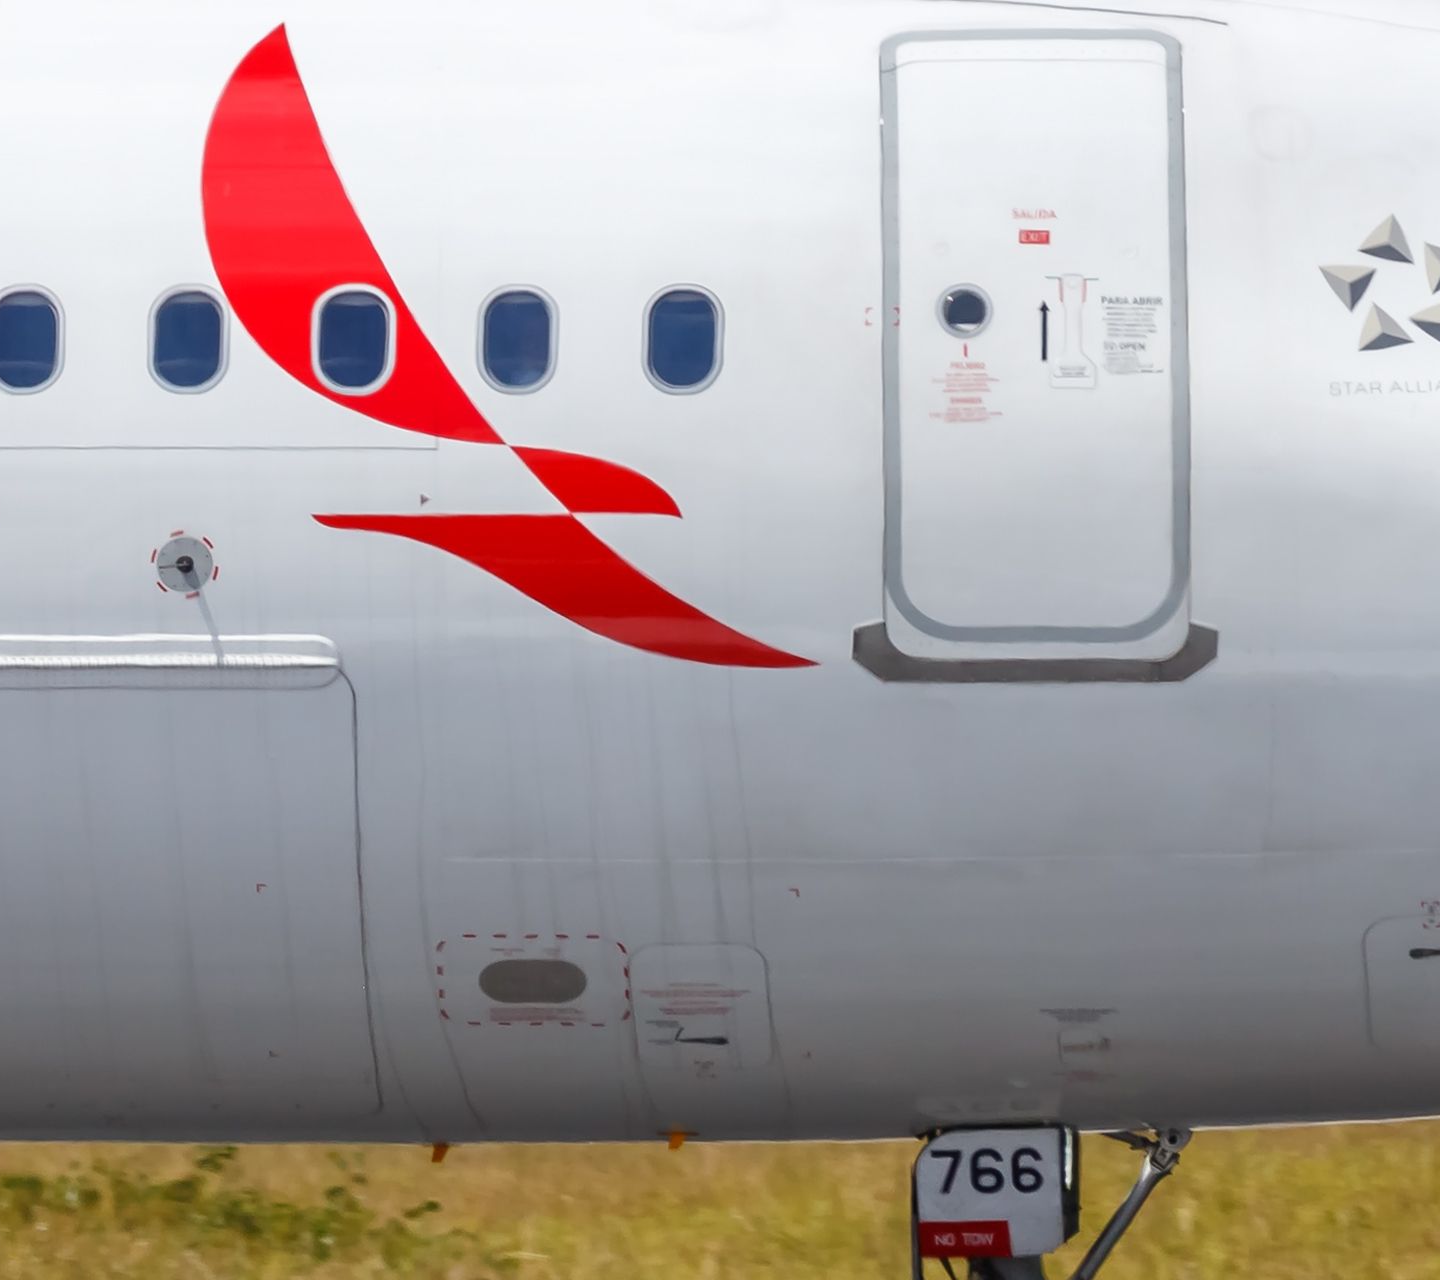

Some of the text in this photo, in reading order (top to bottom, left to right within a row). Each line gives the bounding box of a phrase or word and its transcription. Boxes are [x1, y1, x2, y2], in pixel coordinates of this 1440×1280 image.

[1328, 380, 1383, 397] STAR
[930, 1146, 1044, 1194] 766
[934, 1232, 995, 1246] NO TOW
